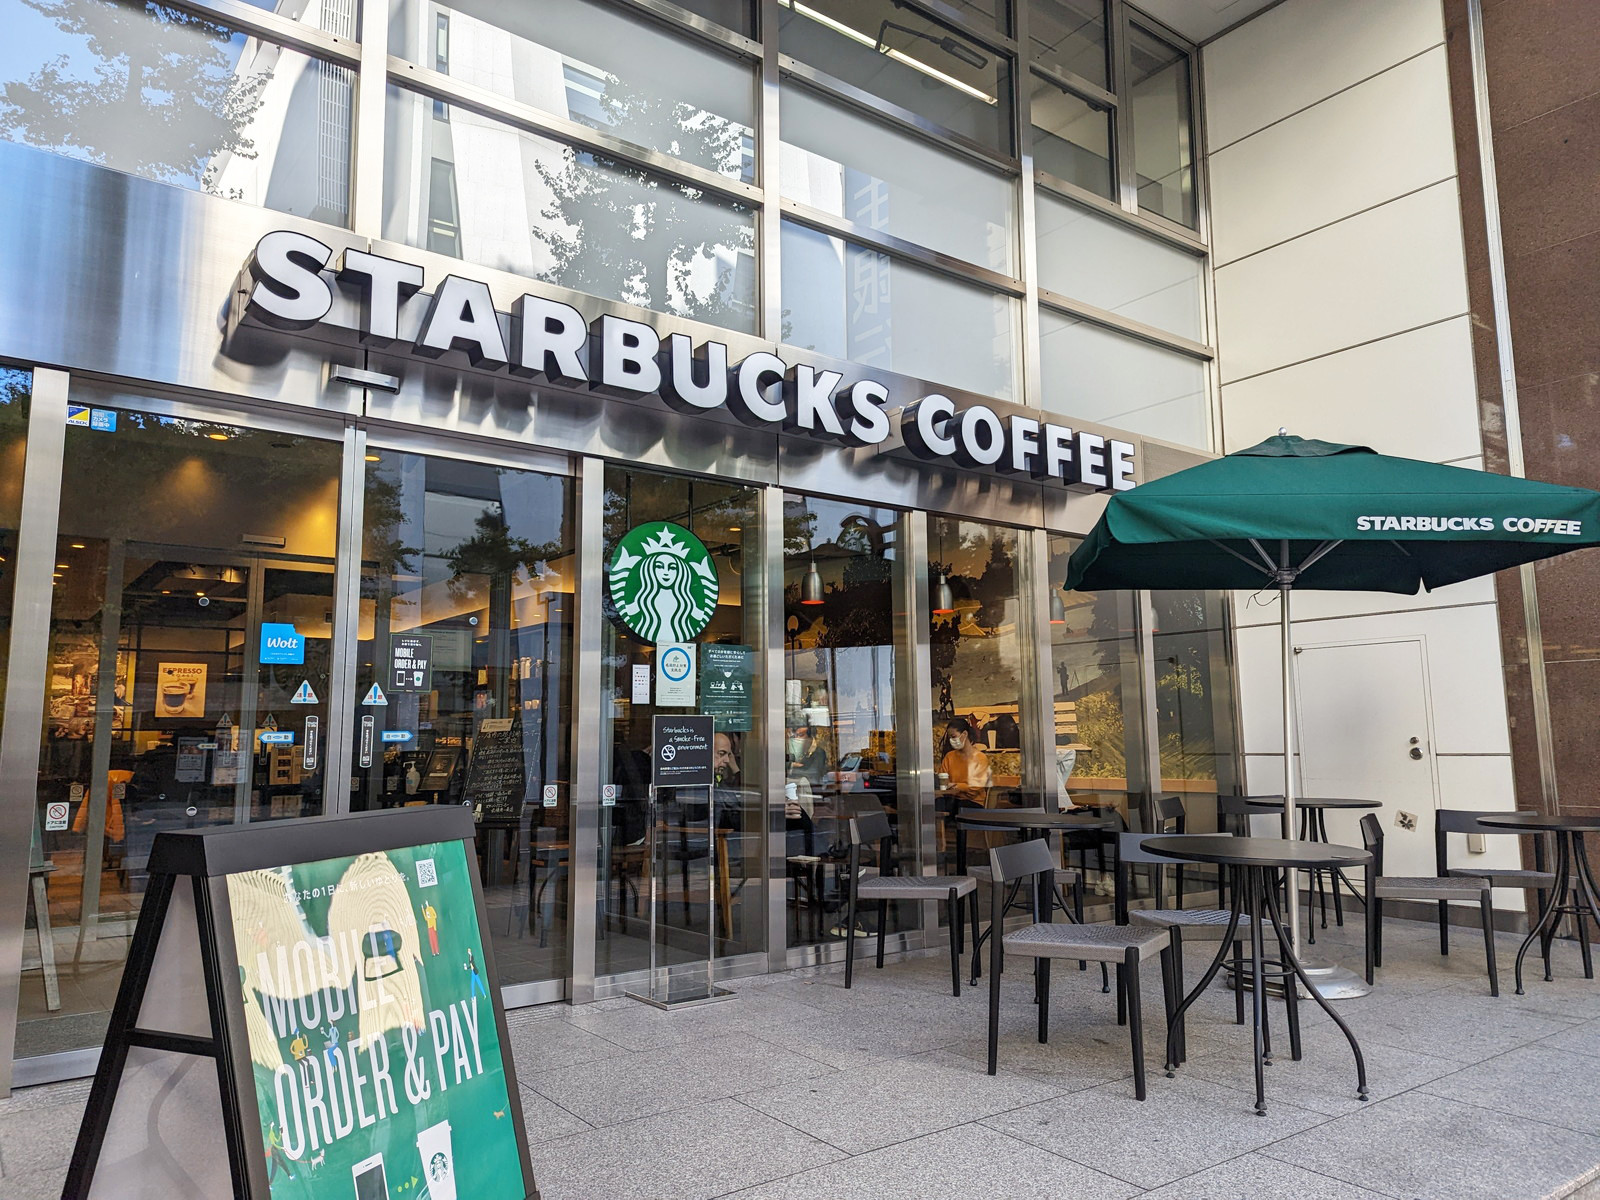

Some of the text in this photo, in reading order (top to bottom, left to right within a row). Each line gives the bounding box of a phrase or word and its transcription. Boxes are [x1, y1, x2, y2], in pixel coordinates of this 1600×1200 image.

[250, 230, 890, 444] STARBUCKS
[914, 394, 1137, 491] COFFEE
[1356, 516, 1582, 536] STARBUCKS COFFEE
[267, 637, 298, 649] Wolt
[394, 647, 415, 659] MOBILE
[394, 658, 428, 670] ORDER & PAY
[663, 726, 690, 734] Starbucks
[256, 921, 395, 1041] MOBILE
[274, 997, 484, 1161] ORDER & PAY
